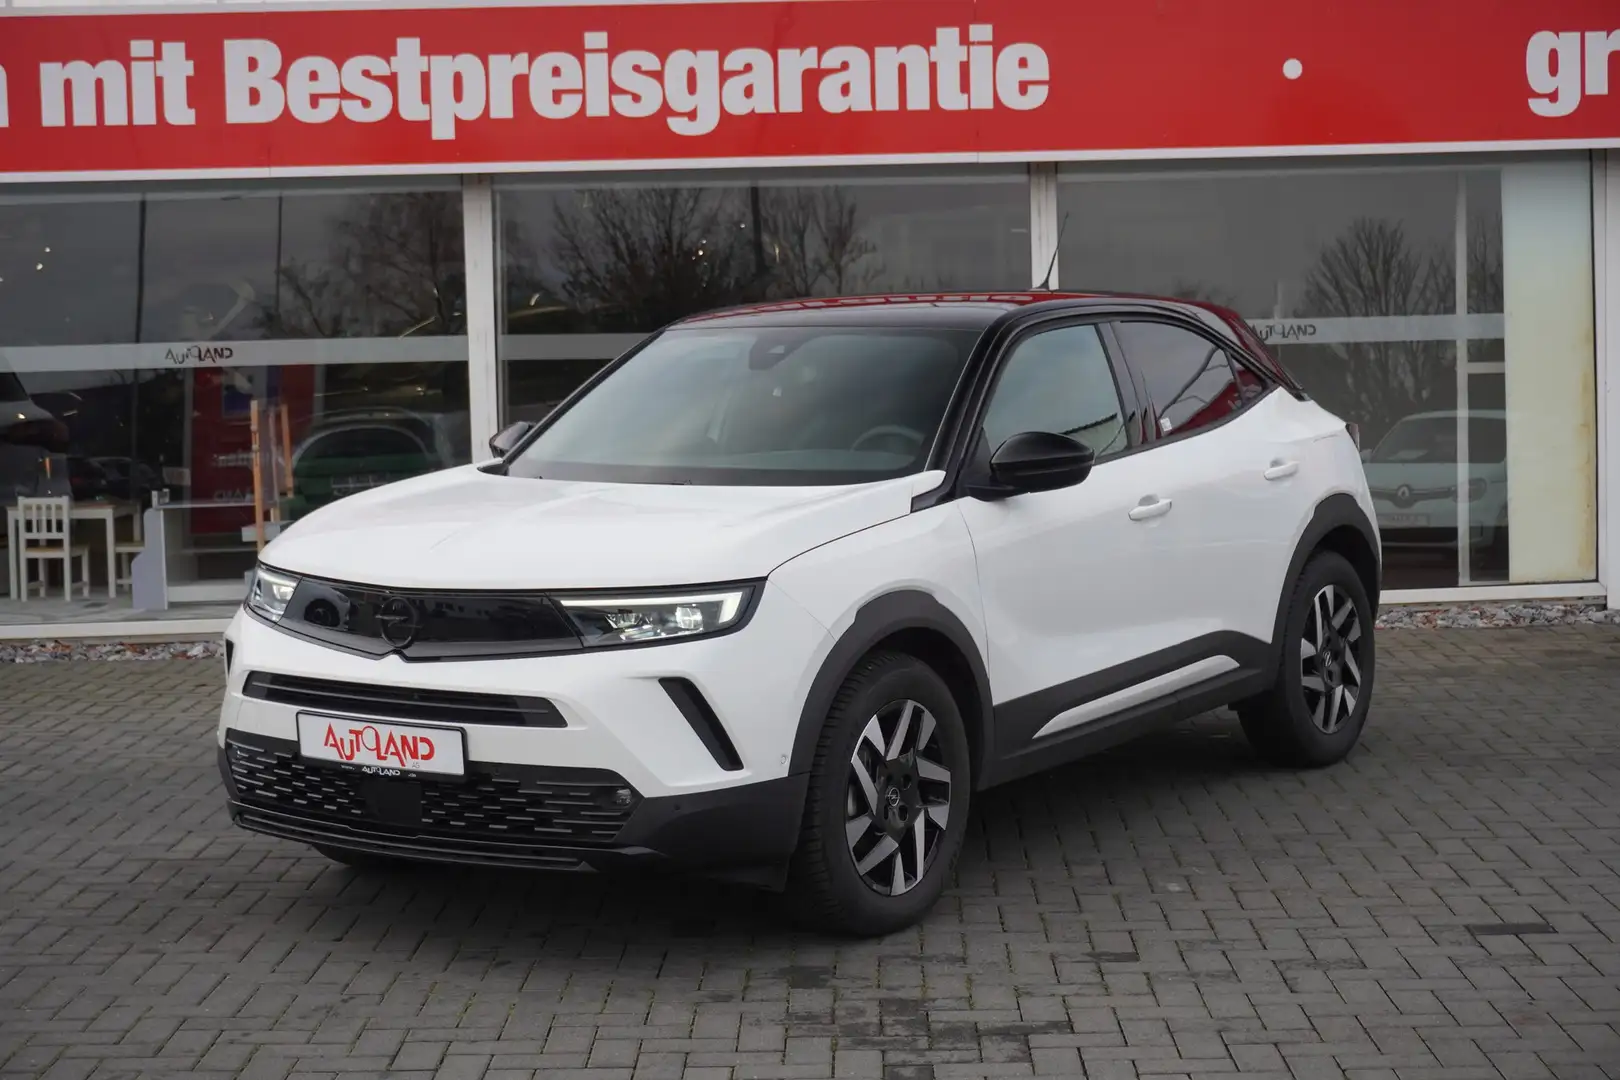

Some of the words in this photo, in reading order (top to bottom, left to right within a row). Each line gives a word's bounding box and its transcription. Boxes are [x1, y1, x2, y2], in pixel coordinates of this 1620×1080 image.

[39, 39, 196, 127] mit
[223, 24, 1050, 141] Bestpreisgarantie
[165, 345, 233, 364] AUTOLAND
[324, 723, 435, 767] AUTOLAND
[362, 766, 401, 777] AUTOLAND
